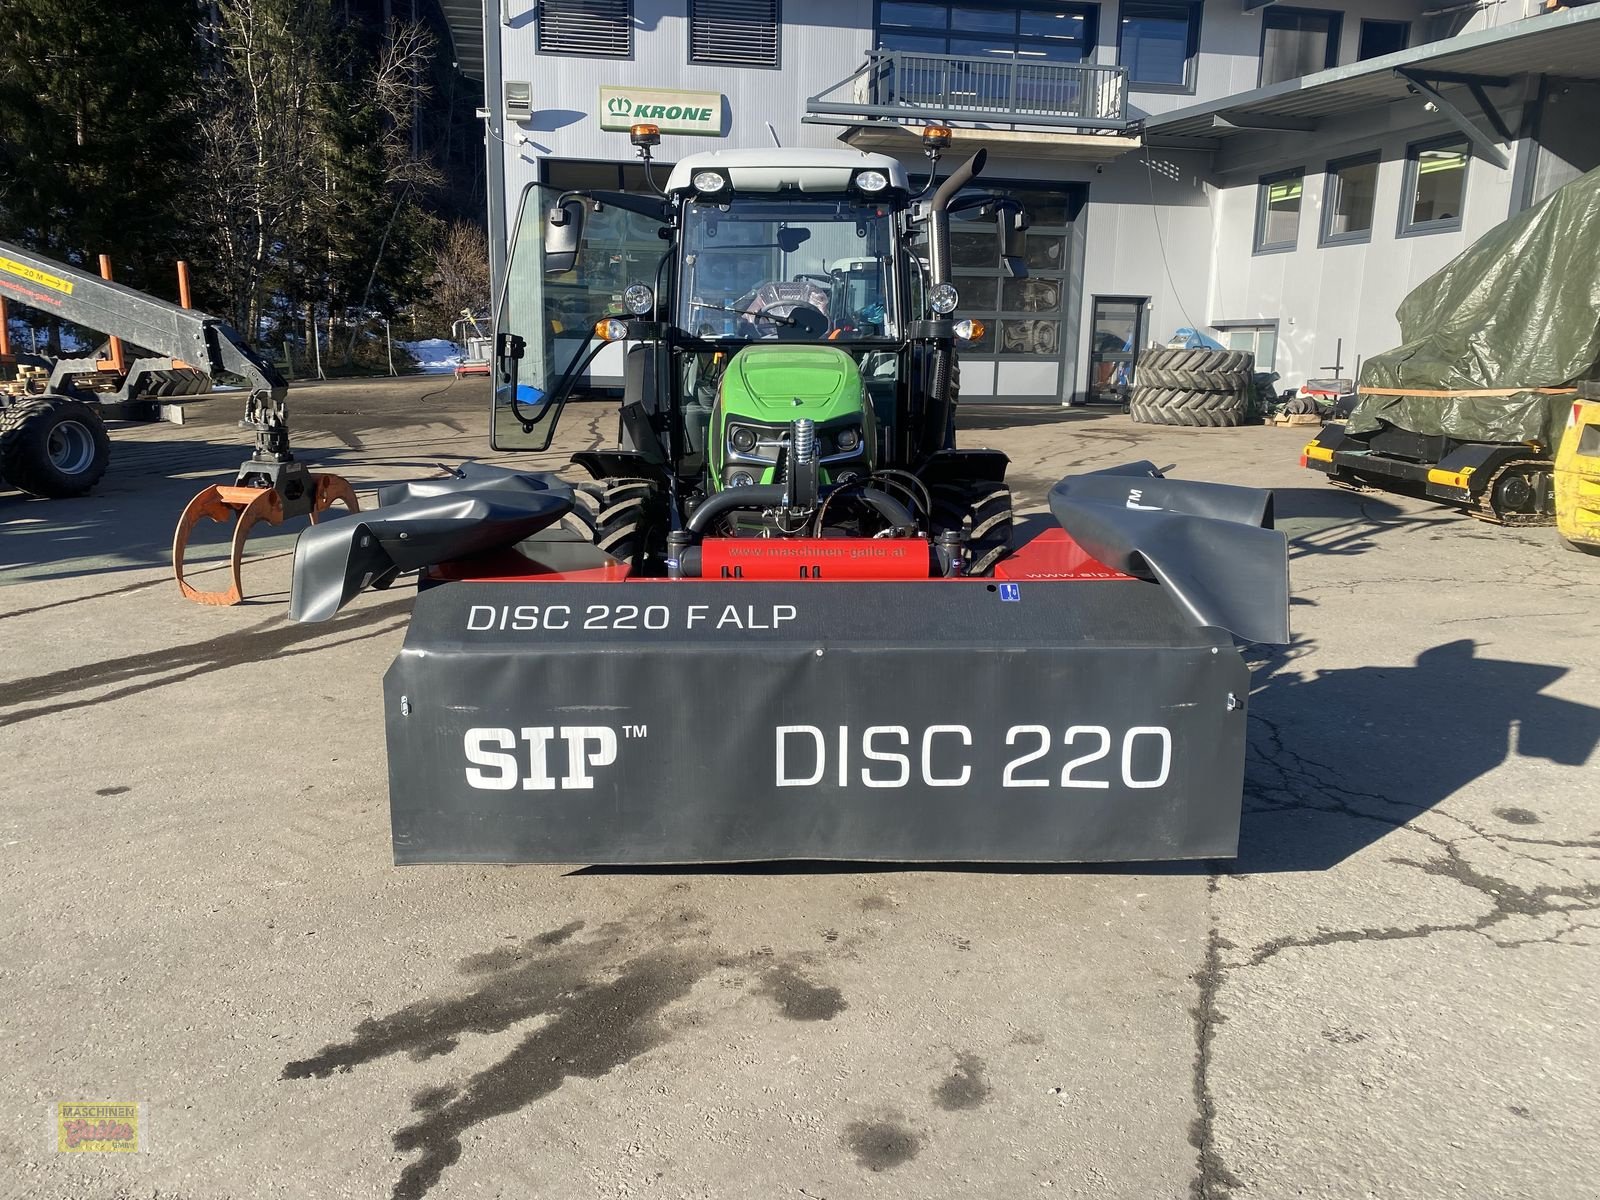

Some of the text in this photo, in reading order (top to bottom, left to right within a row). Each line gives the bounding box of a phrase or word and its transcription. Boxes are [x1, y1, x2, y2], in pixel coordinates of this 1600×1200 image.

[634, 104, 713, 121] KRONE
[24, 269, 44, 281] 20 M
[466, 605, 797, 631] DISC 220 F ALP
[464, 726, 618, 791] SIP
[775, 724, 1172, 789] DISC 220
